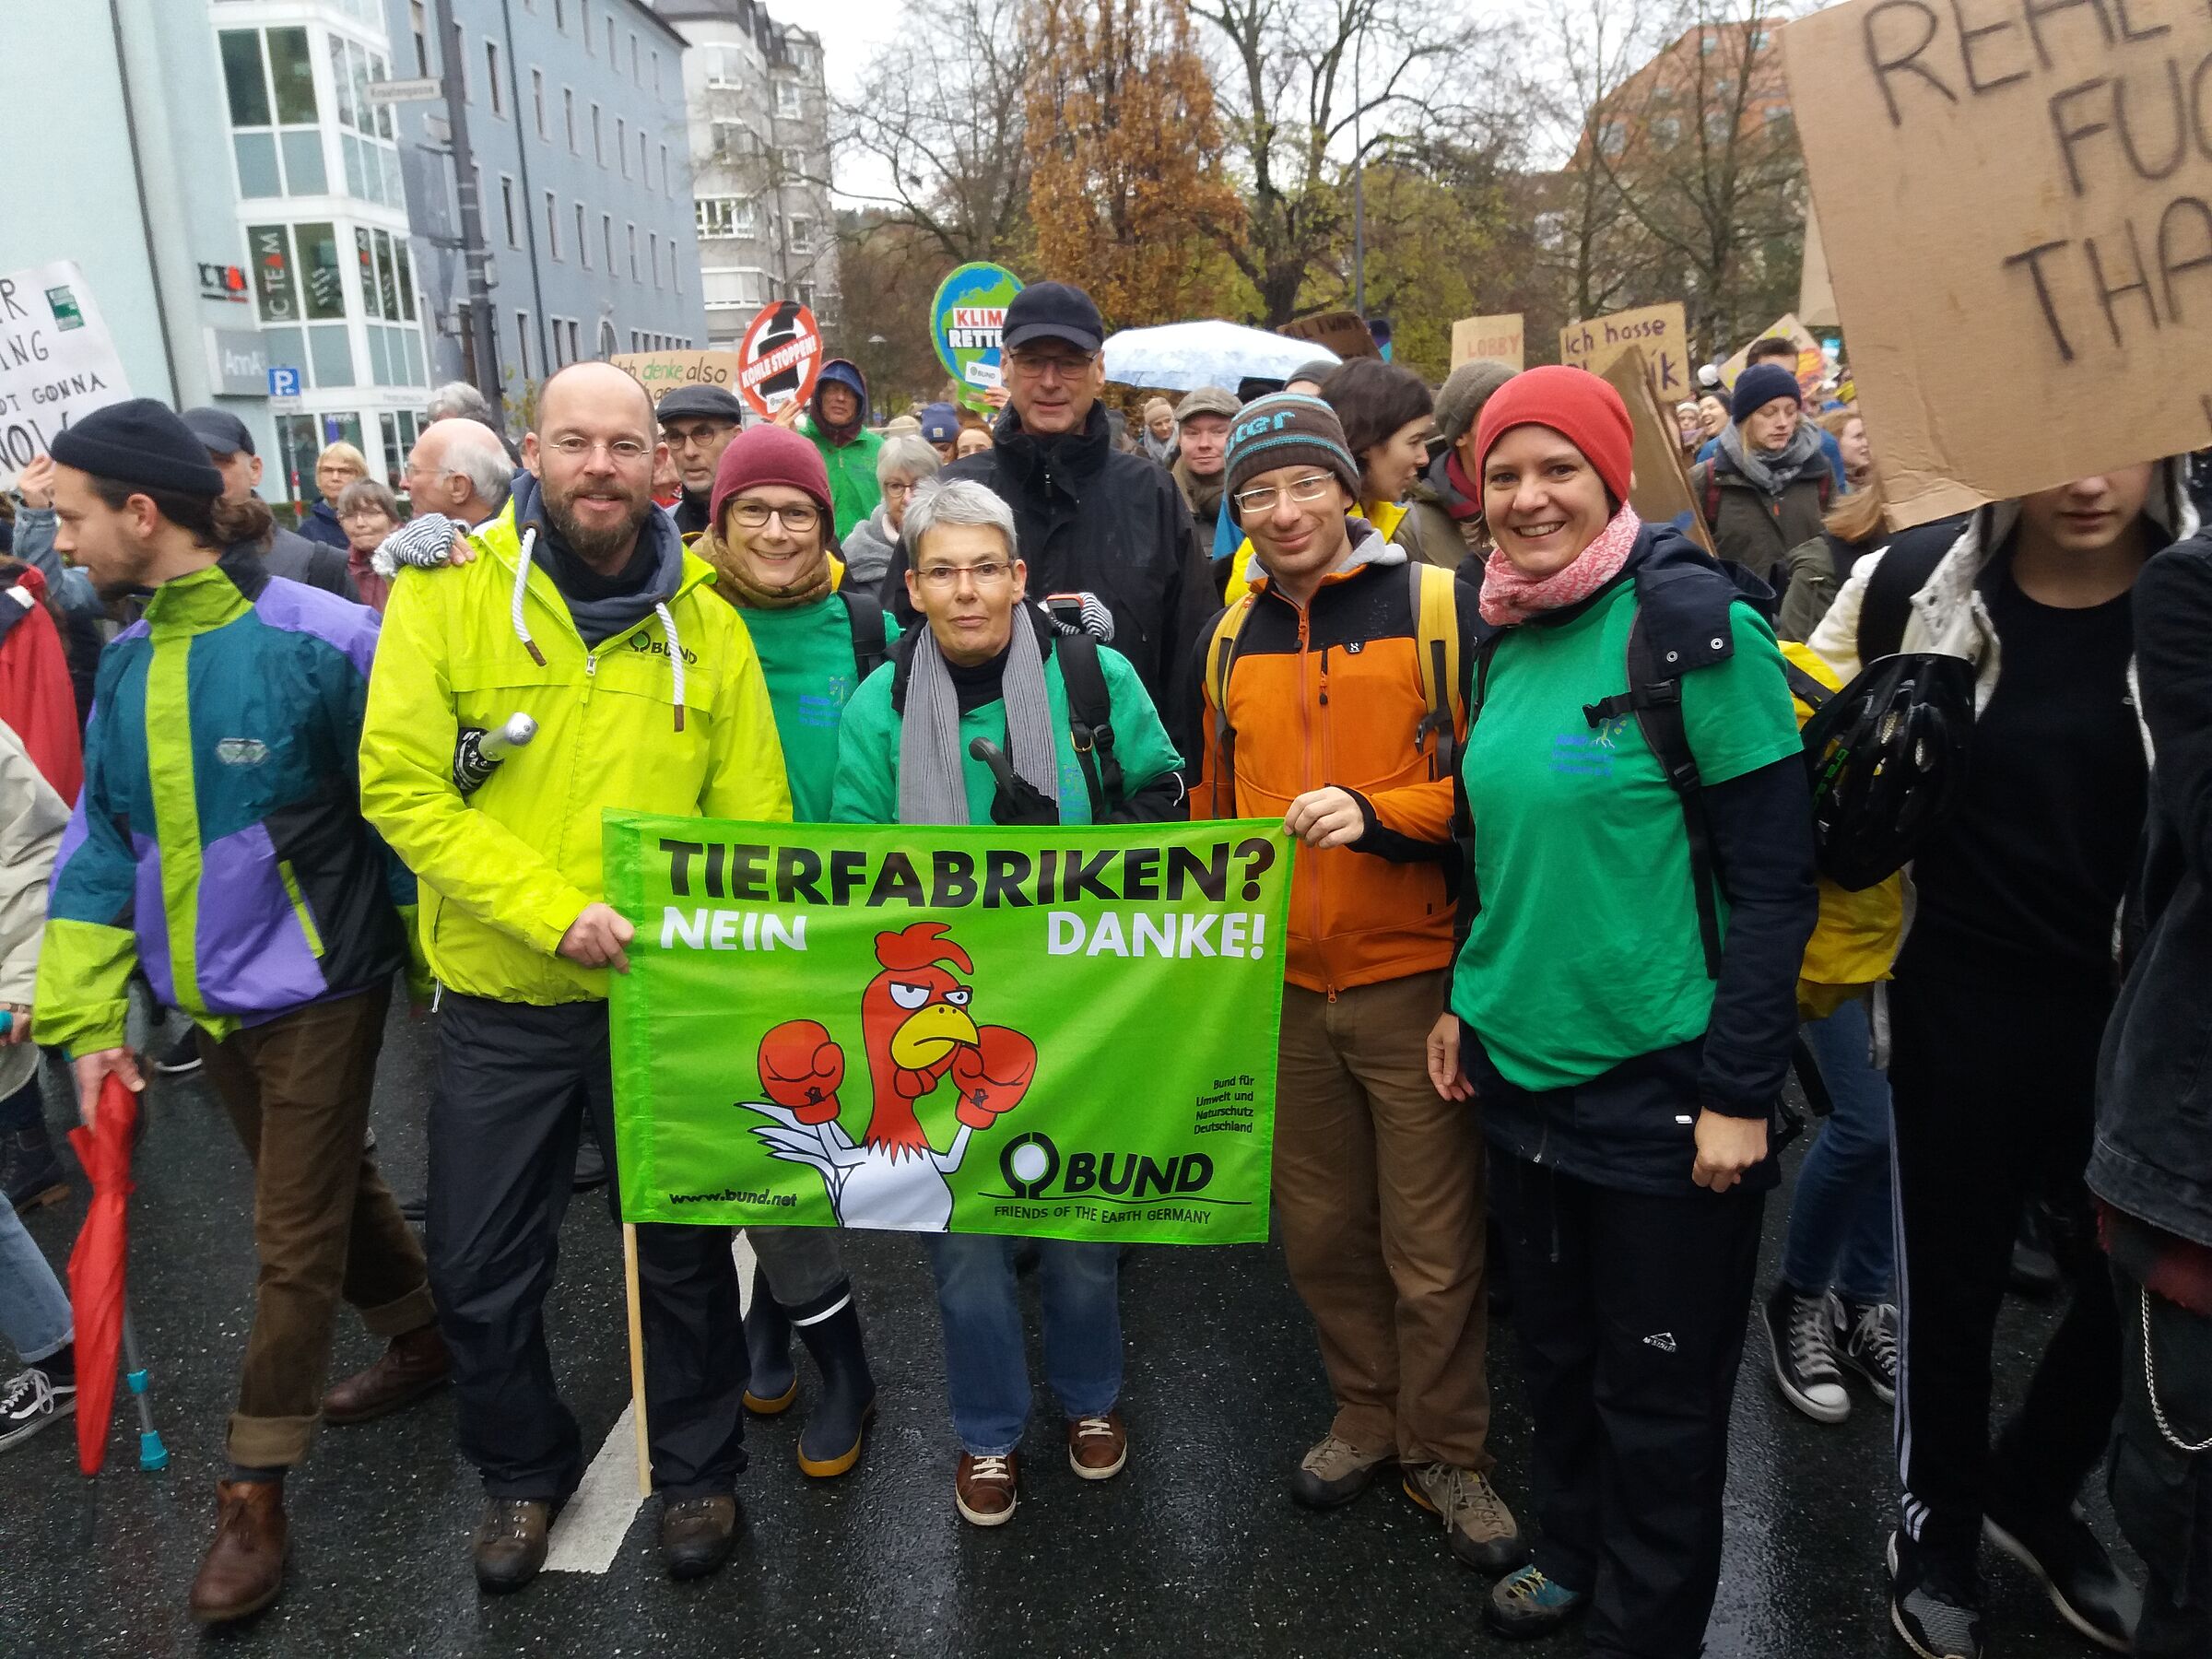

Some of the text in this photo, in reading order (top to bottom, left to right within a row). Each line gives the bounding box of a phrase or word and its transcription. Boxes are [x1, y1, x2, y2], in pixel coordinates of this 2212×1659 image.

[1466, 333, 1521, 359] LOBBY
[1565, 328, 1594, 354] Ich
[686, 356, 728, 384] also
[741, 335, 818, 388] KOHLE STOPPEN!
[32, 371, 108, 404] GONNA
[275, 371, 293, 396] P
[659, 837, 1276, 909] TIERFABRIKEN?
[661, 906, 1265, 959] NEIN DANKE!
[1213, 1075, 1254, 1089] Bund für
[1196, 1091, 1253, 1106] Umwelt und
[1196, 1106, 1253, 1121] Naturschutz
[1194, 1121, 1253, 1135] Deutschland
[1063, 1152, 1214, 1197] BUND
[669, 1189, 797, 1206] www.bund.net
[994, 1206, 1211, 1225] FRIENDS OF THE EARTH GERMANY
